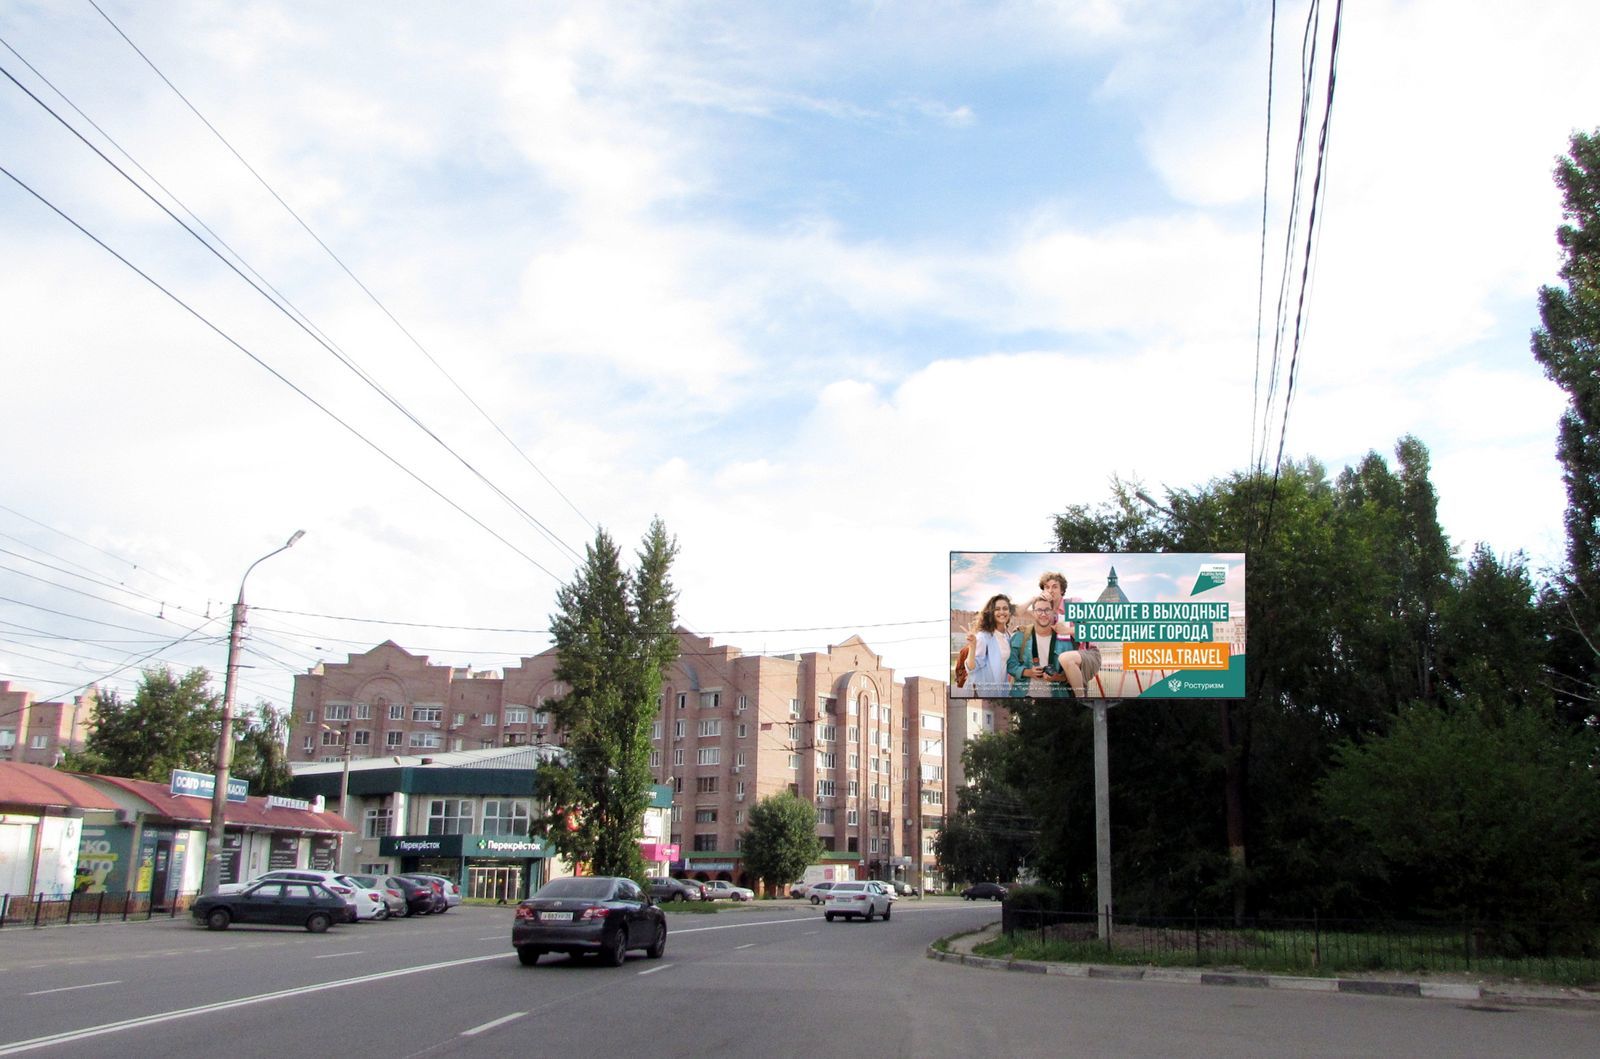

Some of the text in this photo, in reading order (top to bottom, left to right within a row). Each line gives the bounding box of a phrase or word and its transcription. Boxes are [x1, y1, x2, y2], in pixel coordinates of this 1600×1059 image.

[1068, 604, 1227, 621] ВЫХОДИТЕ В ВЫХОДНЫЕ
[1078, 624, 1209, 641] В СОСЕДНИЕ ГОРОДА
[1129, 649, 1223, 665] RUSSIA.TRAVEL
[1184, 681, 1224, 691] Ростуризм
[400, 840, 440, 851] Перекрёсток
[487, 839, 541, 851] Перекрёсток
